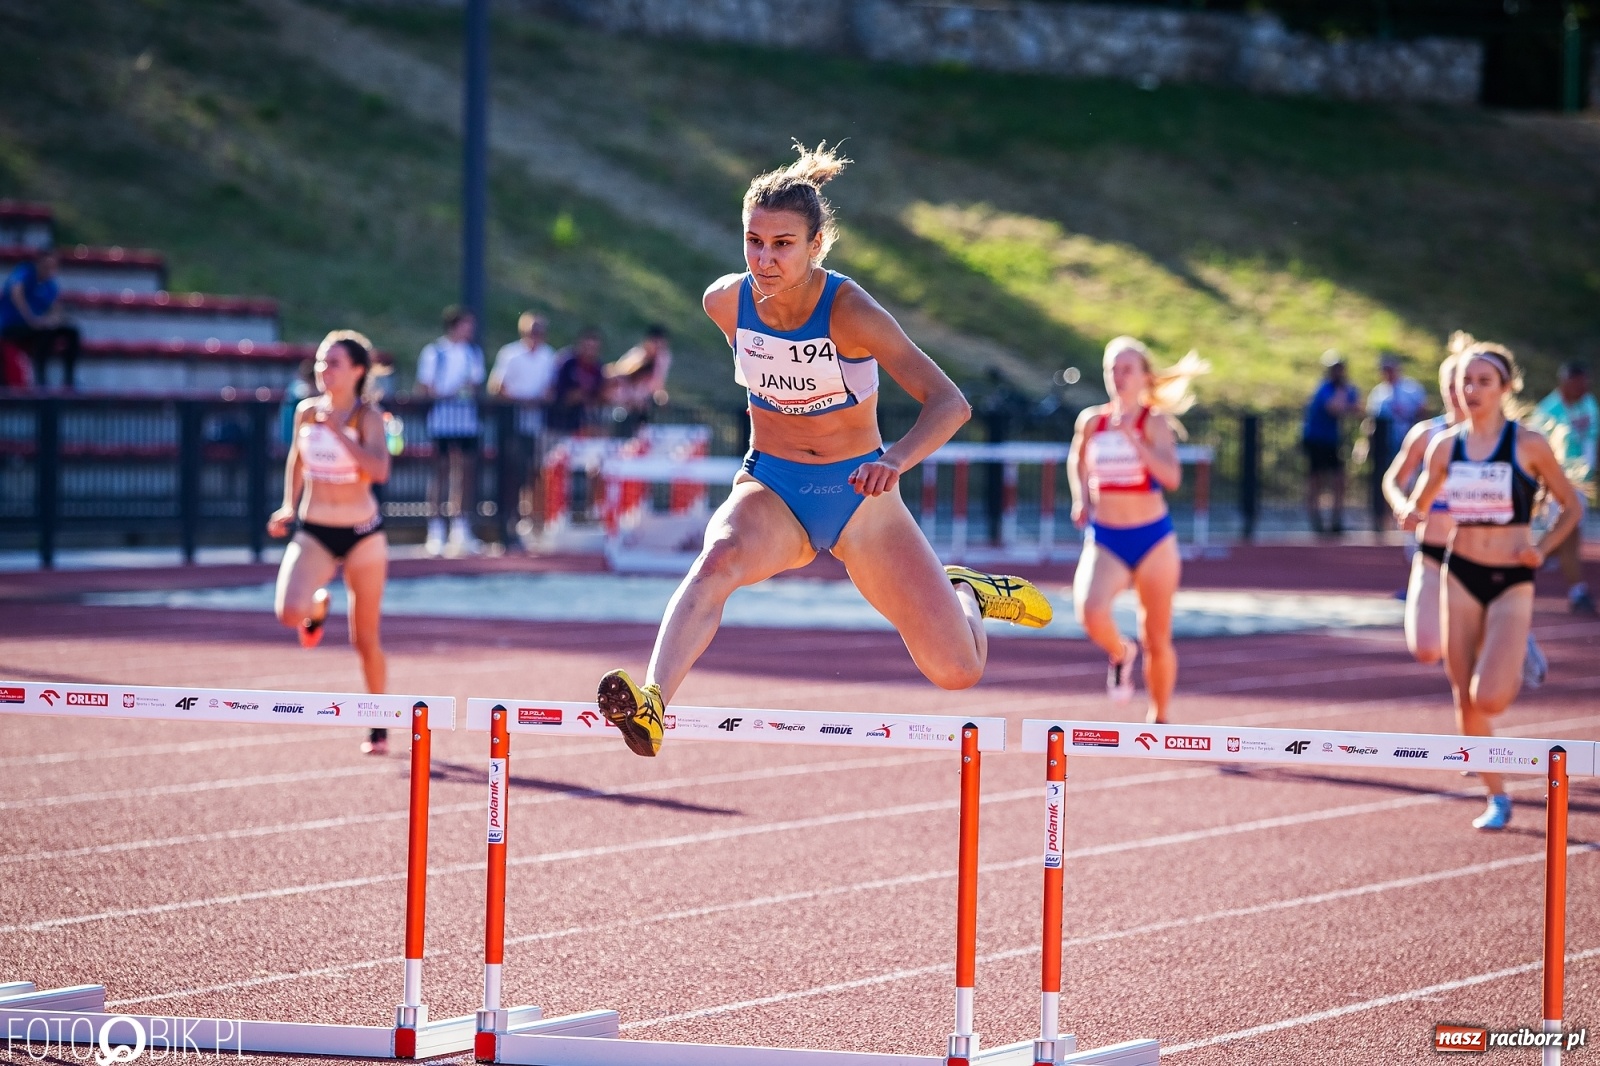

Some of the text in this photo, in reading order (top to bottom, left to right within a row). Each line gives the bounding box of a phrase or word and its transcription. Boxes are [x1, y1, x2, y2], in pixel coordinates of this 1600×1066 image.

[788, 342, 834, 364] 194
[759, 373, 817, 391] JANUS
[808, 397, 833, 412] 2019
[68, 693, 106, 706] ORLEN
[175, 697, 199, 711] 4F
[272, 705, 305, 714] 4MOVE
[383, 710, 394, 718] KIDS
[718, 717, 743, 731] 4F
[820, 726, 853, 735] 4MOVE
[936, 733, 947, 741] KIDS
[1167, 737, 1208, 749] ORLEN
[1285, 740, 1311, 754] 4F
[1393, 750, 1429, 759] 4MOVE
[1488, 756, 1517, 764] HEALTHIER
[490, 780, 501, 828] polanik
[1047, 803, 1059, 852] polanik
